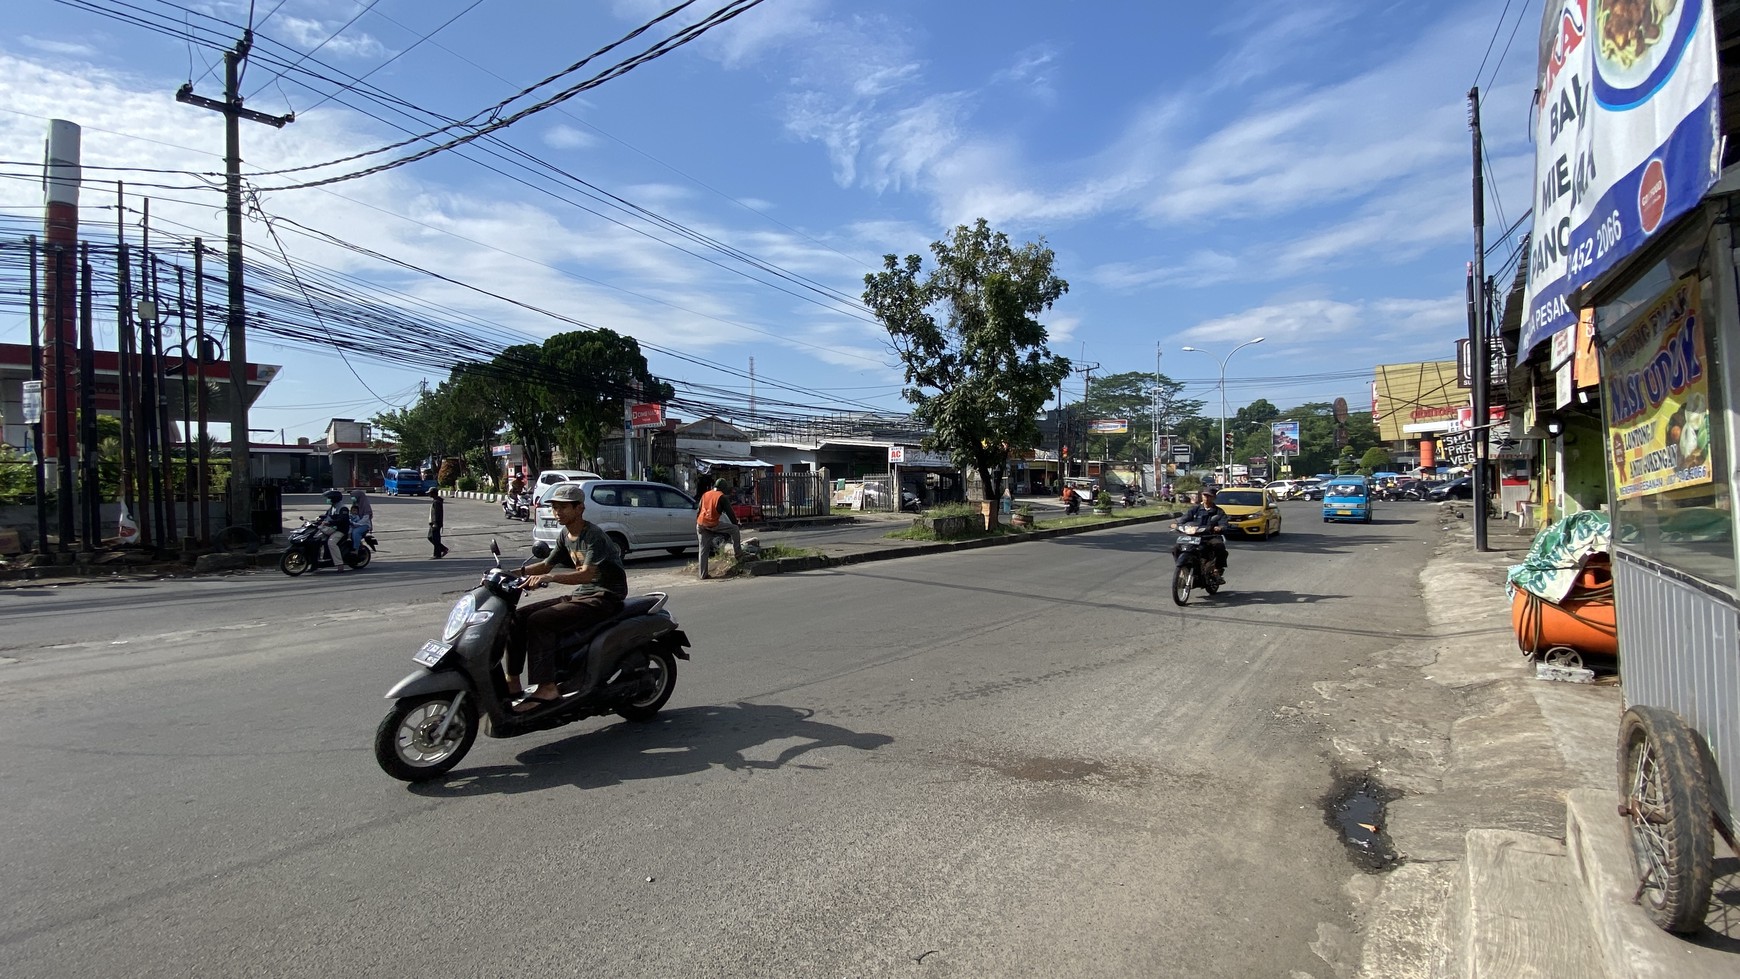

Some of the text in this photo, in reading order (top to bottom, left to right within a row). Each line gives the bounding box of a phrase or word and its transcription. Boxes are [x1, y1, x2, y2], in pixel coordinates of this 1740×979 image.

[1541, 153, 1572, 216] MIE
[1596, 208, 1623, 260] 2066
[1610, 313, 1702, 427] NASI UDUK
[891, 450, 901, 458] AC
